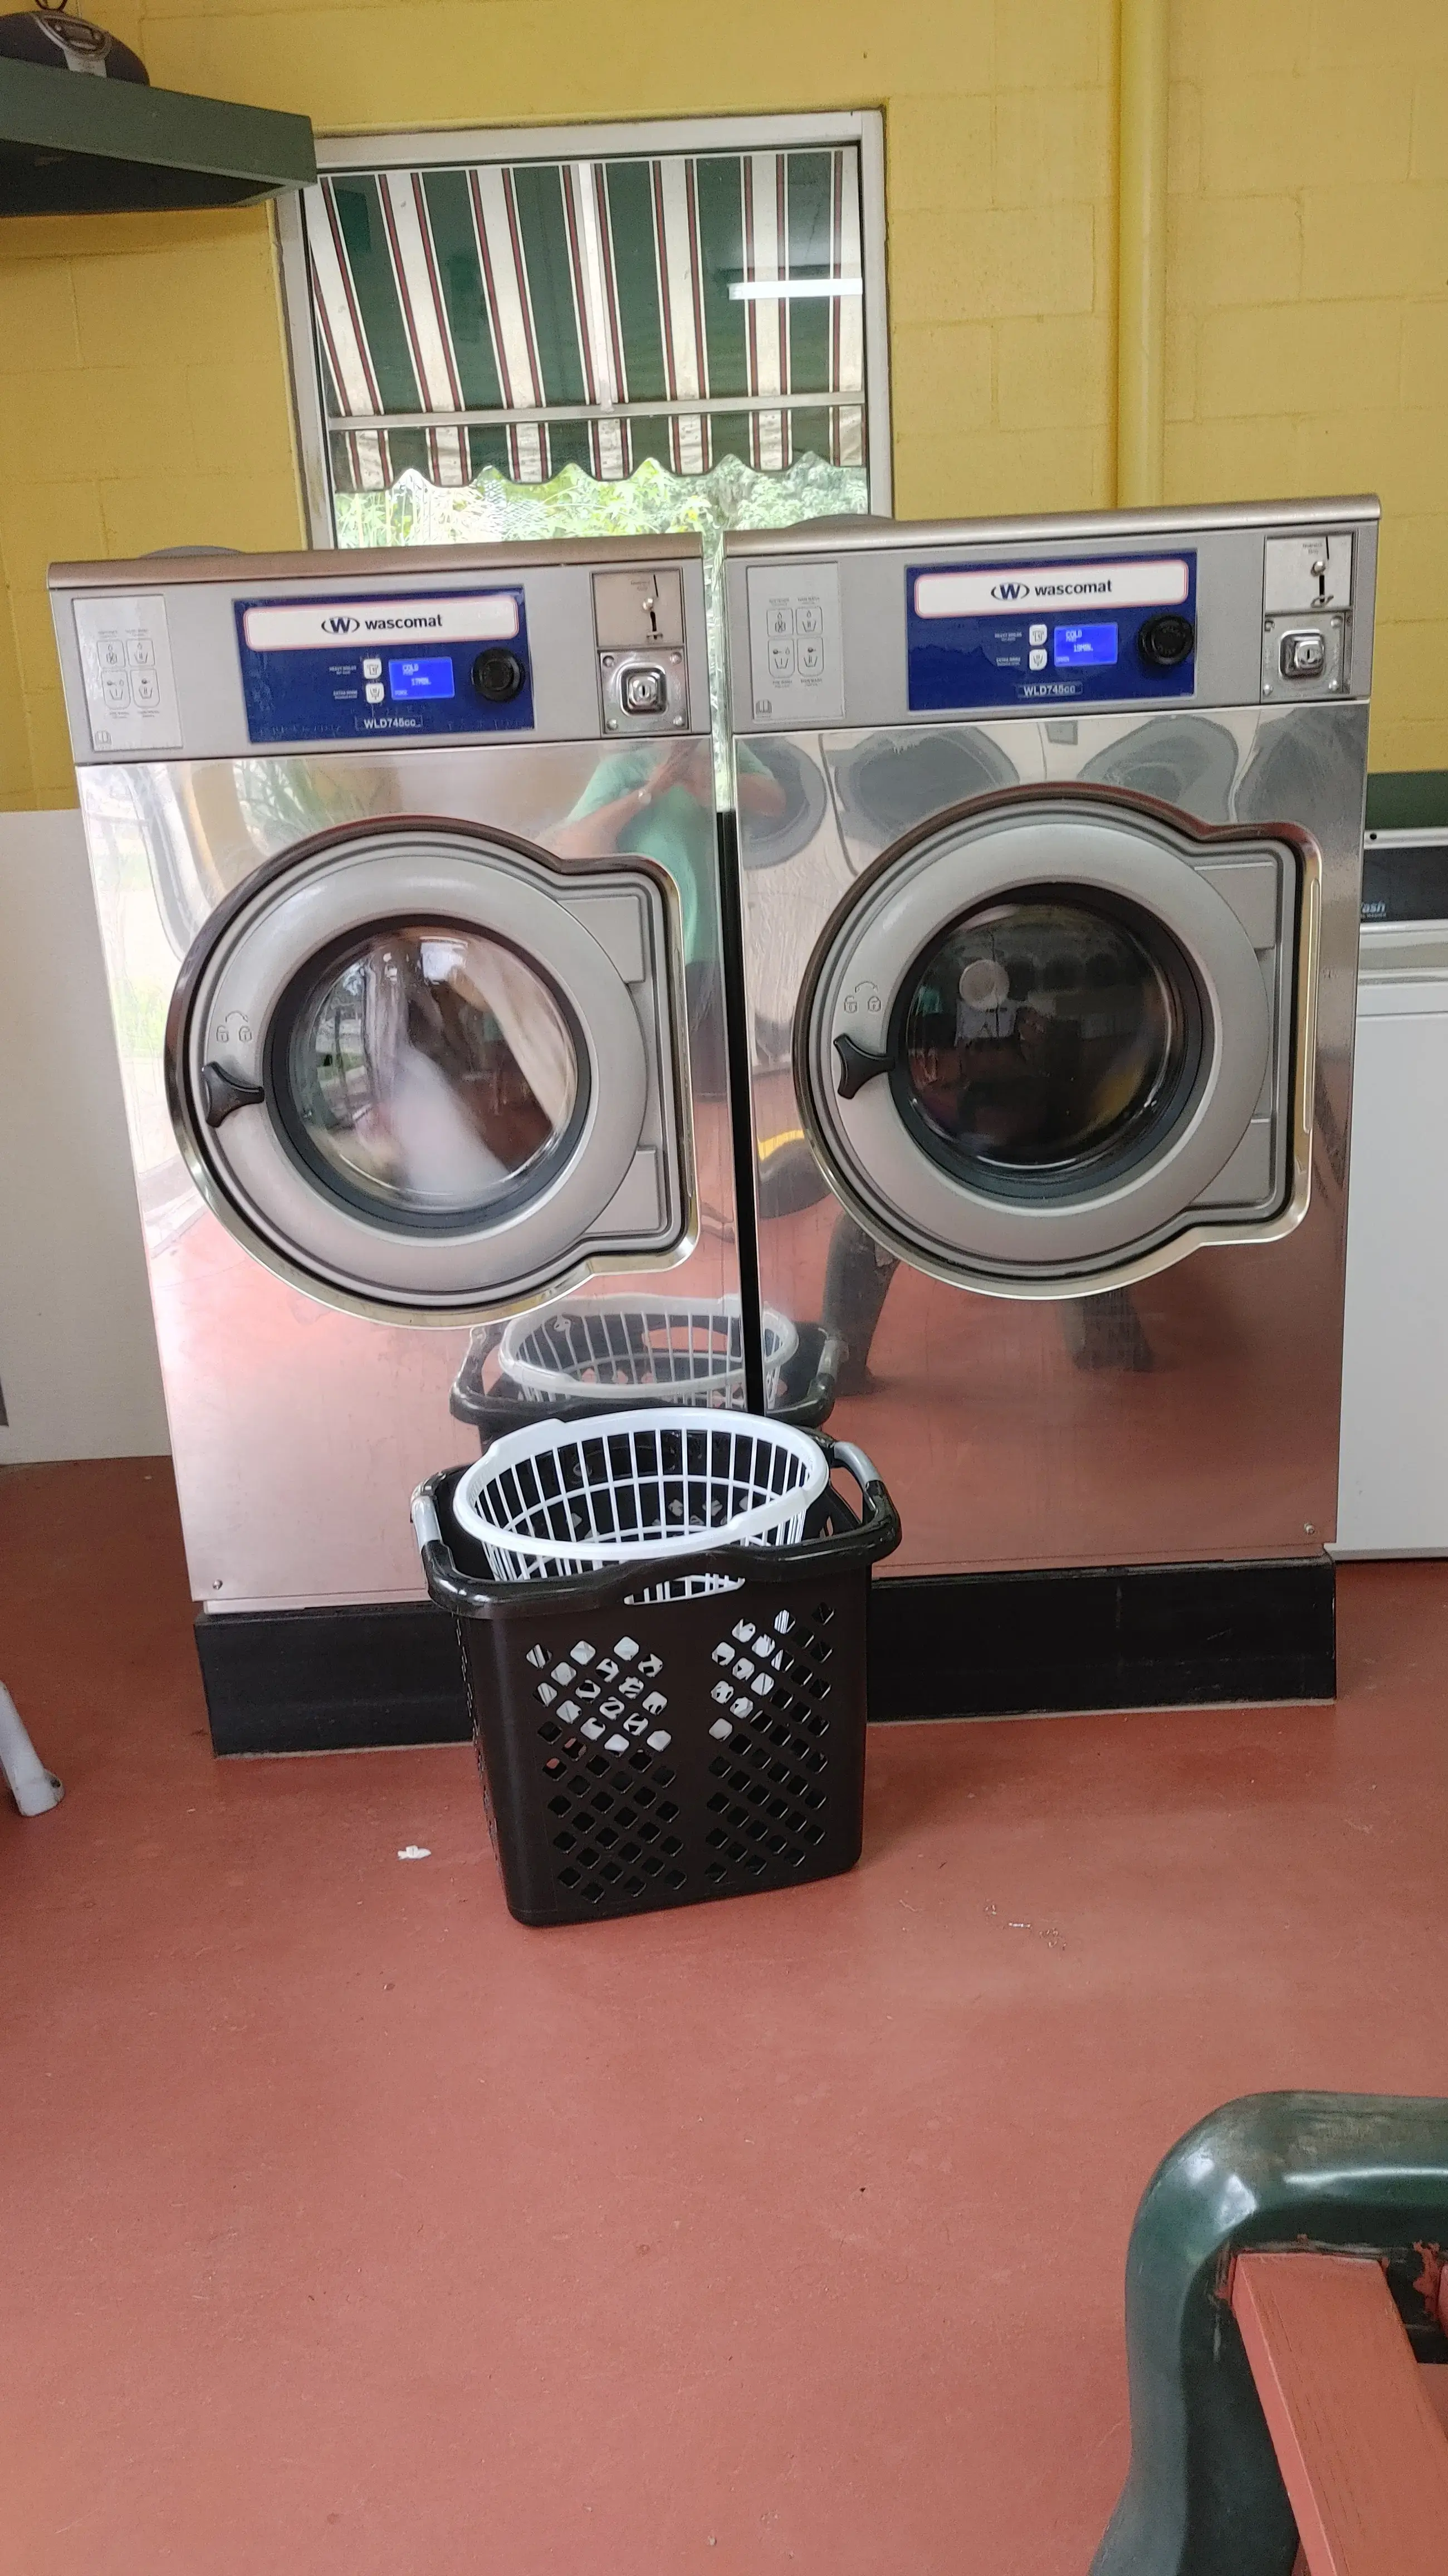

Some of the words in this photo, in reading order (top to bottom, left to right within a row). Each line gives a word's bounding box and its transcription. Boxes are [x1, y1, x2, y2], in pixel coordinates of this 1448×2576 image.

[1035, 579, 1112, 596] wascomat
[365, 614, 443, 630] wascomat
[403, 663, 419, 672] COLD
[1361, 901, 1386, 913] ash
